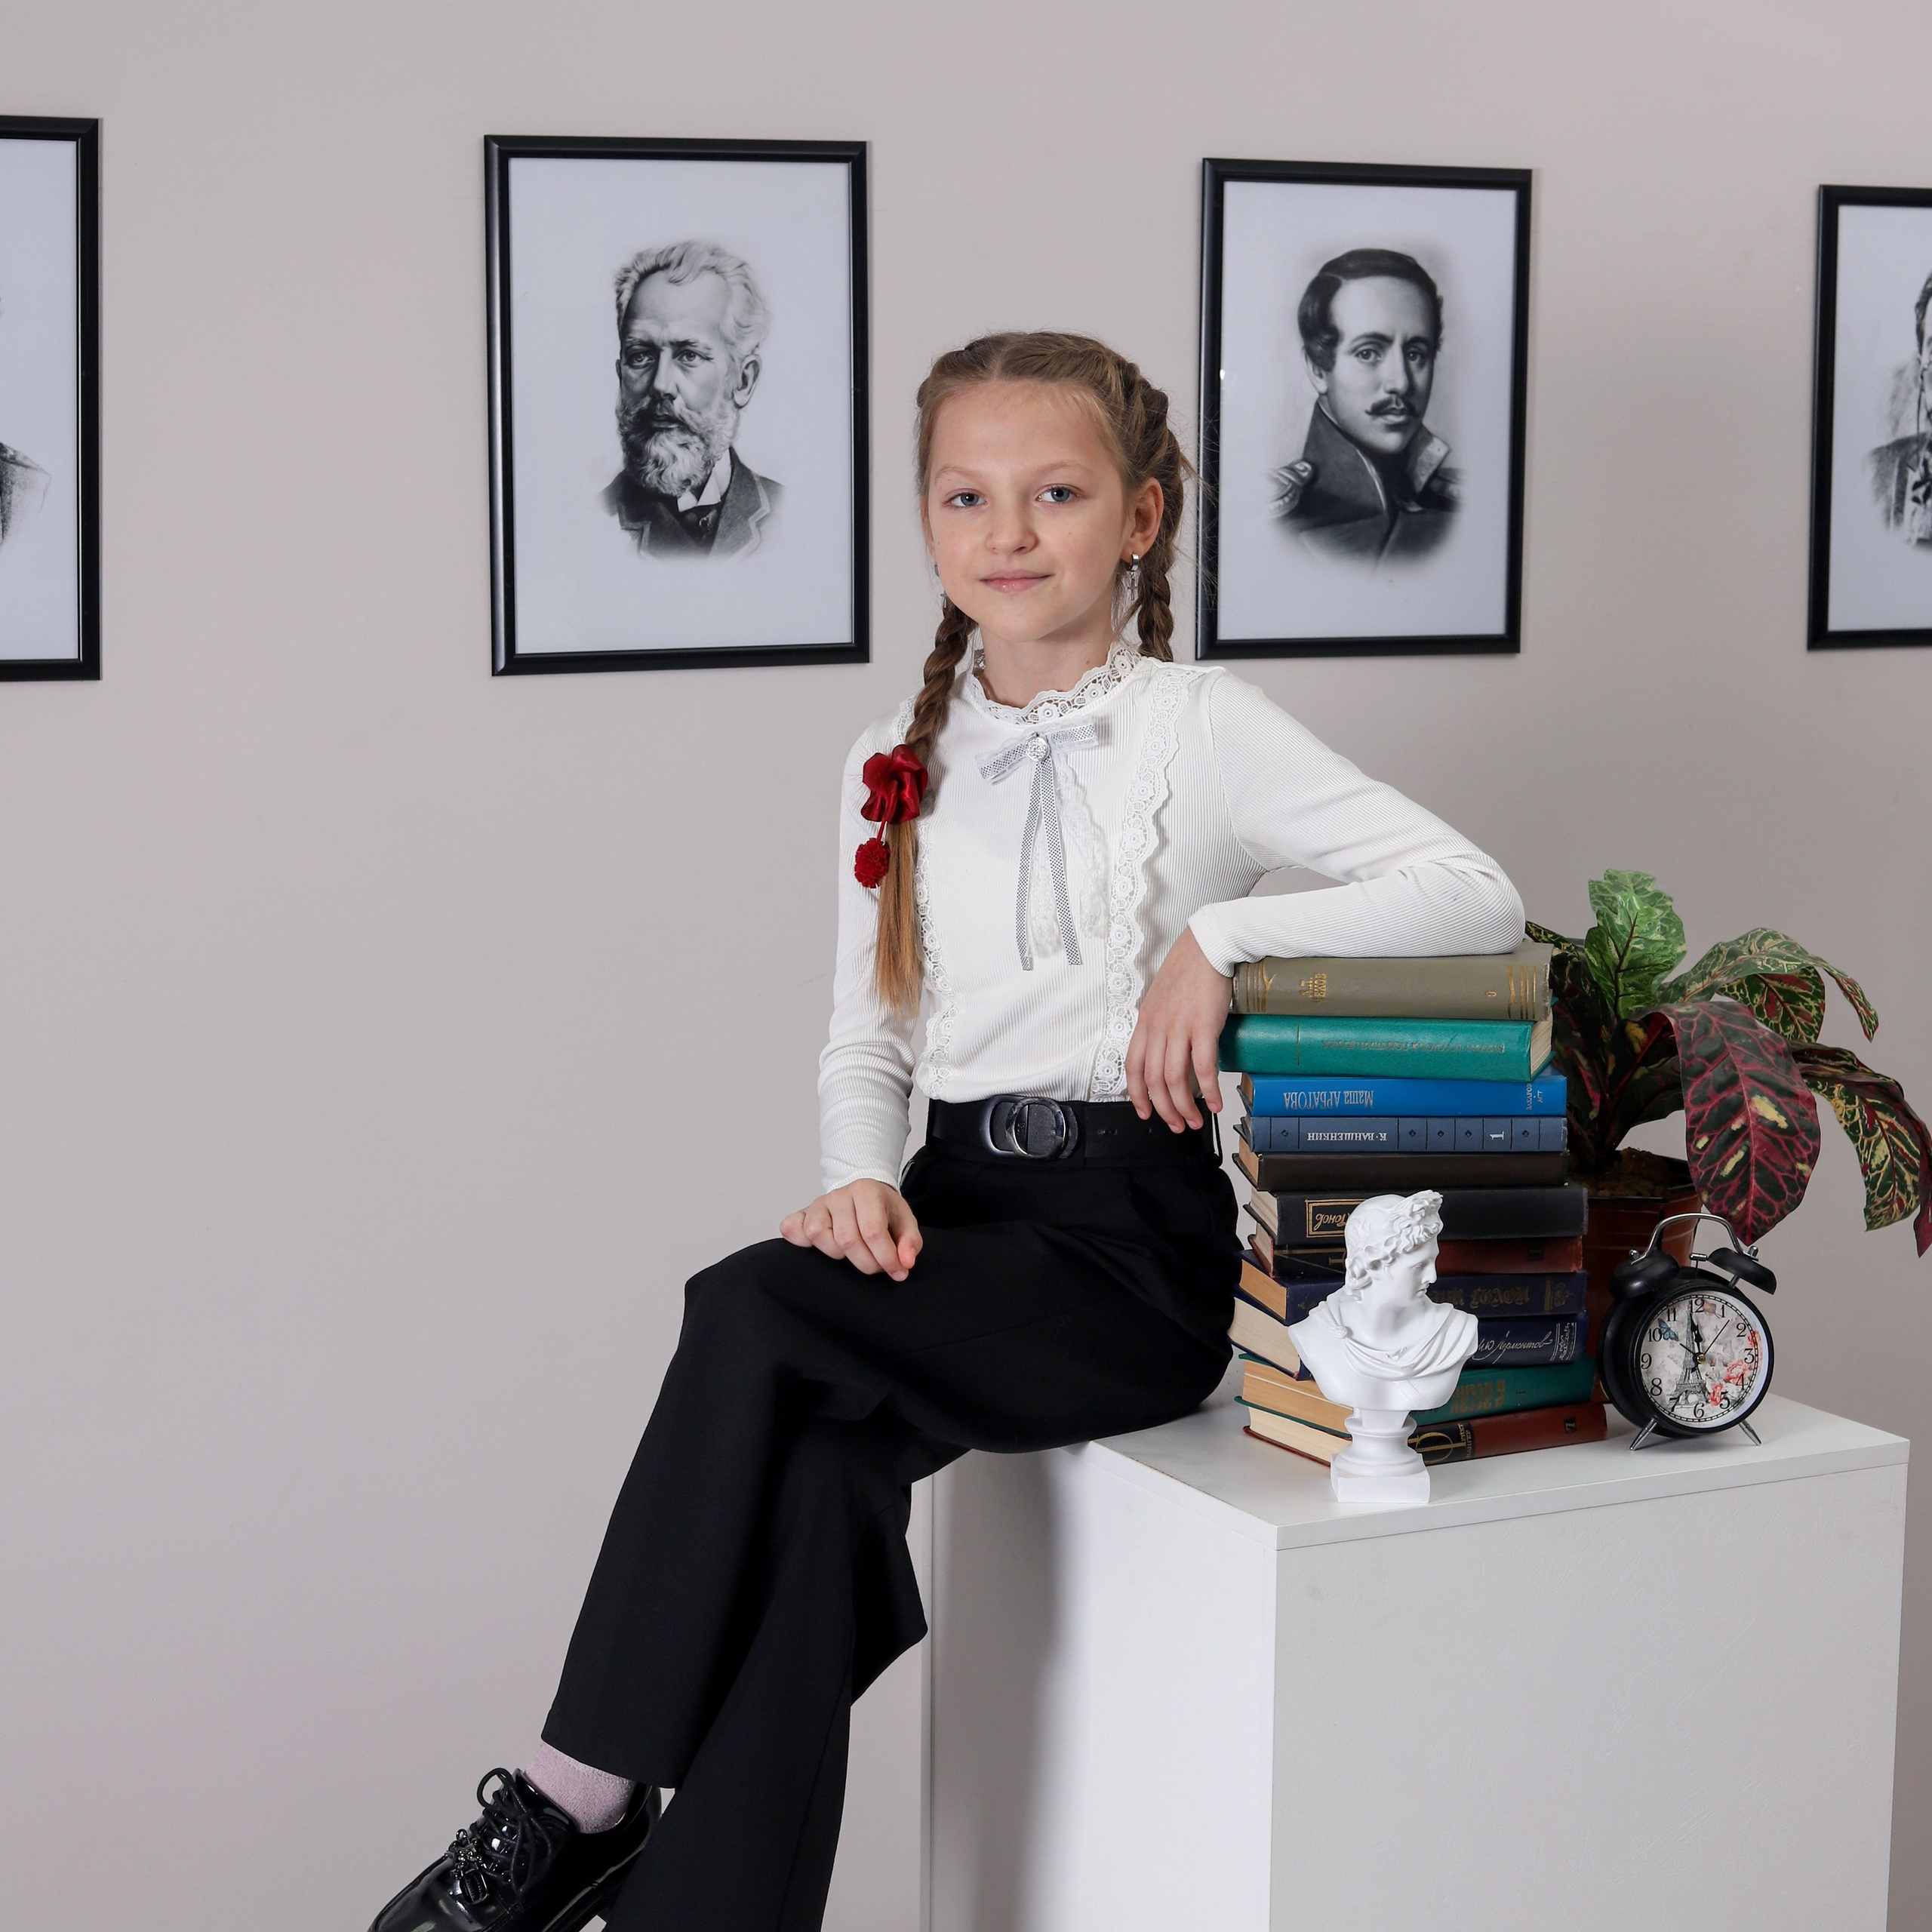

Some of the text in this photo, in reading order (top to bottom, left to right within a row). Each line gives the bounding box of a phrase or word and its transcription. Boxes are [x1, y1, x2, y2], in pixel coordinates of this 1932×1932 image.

[1282, 1090, 1374, 1110] Маша АРБАТОВА
[1489, 1131, 1505, 1140] 1
[1690, 1298, 1705, 1313] 12
[1719, 1304, 1726, 1318] 1
[1666, 1307, 1677, 1321] 11
[1647, 1327, 1662, 1342] 10
[1736, 1323, 1747, 1338] 2
[1641, 1352, 1652, 1369] 9
[1744, 1348, 1755, 1364] 3
[1650, 1377, 1663, 1396] 8
[1736, 1374, 1749, 1390] 4
[1669, 1397, 1679, 1413] 7
[1720, 1391, 1730, 1410] 5
[1694, 1403, 1704, 1418] 6
